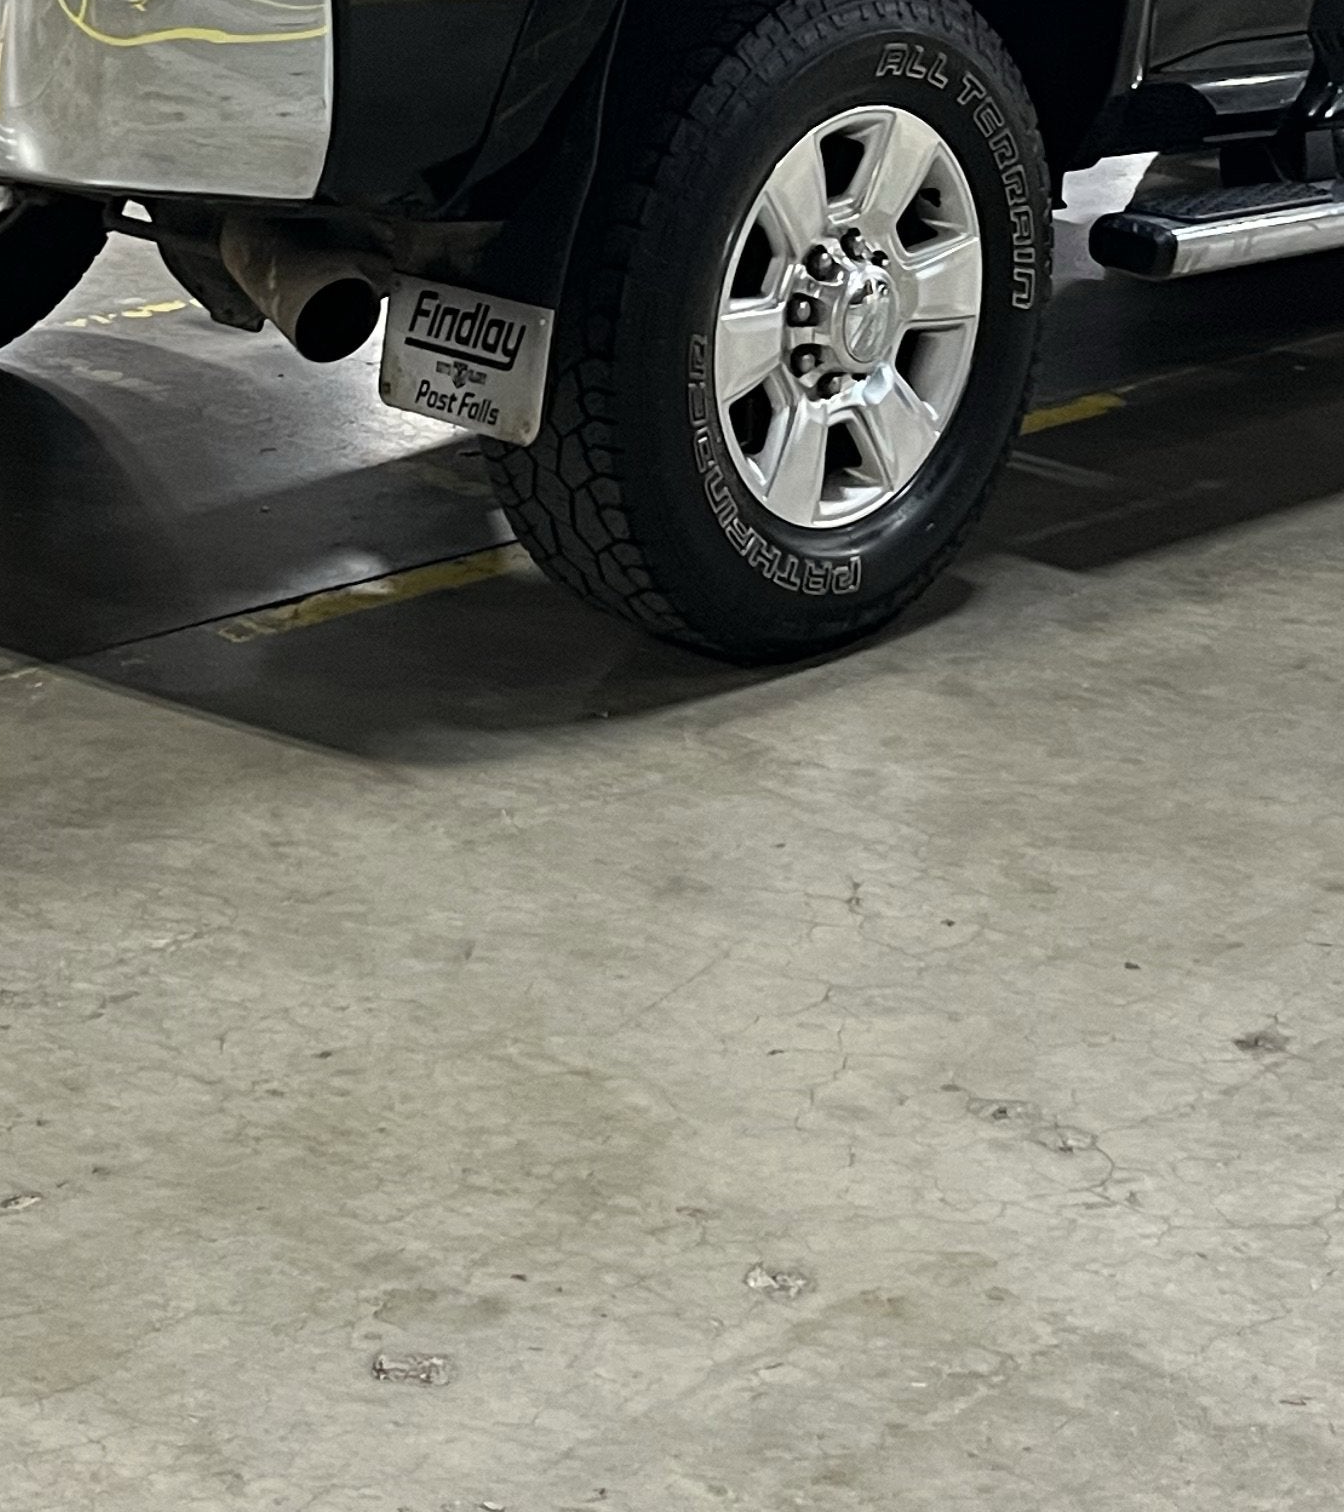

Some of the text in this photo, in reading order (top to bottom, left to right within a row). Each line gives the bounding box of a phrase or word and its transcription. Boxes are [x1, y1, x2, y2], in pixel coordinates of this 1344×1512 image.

[875, 42, 1036, 311] ALL TERRAIN
[408, 290, 527, 369] Findlay
[415, 379, 500, 426] Post Falls
[688, 334, 862, 595] PATHFINDER
